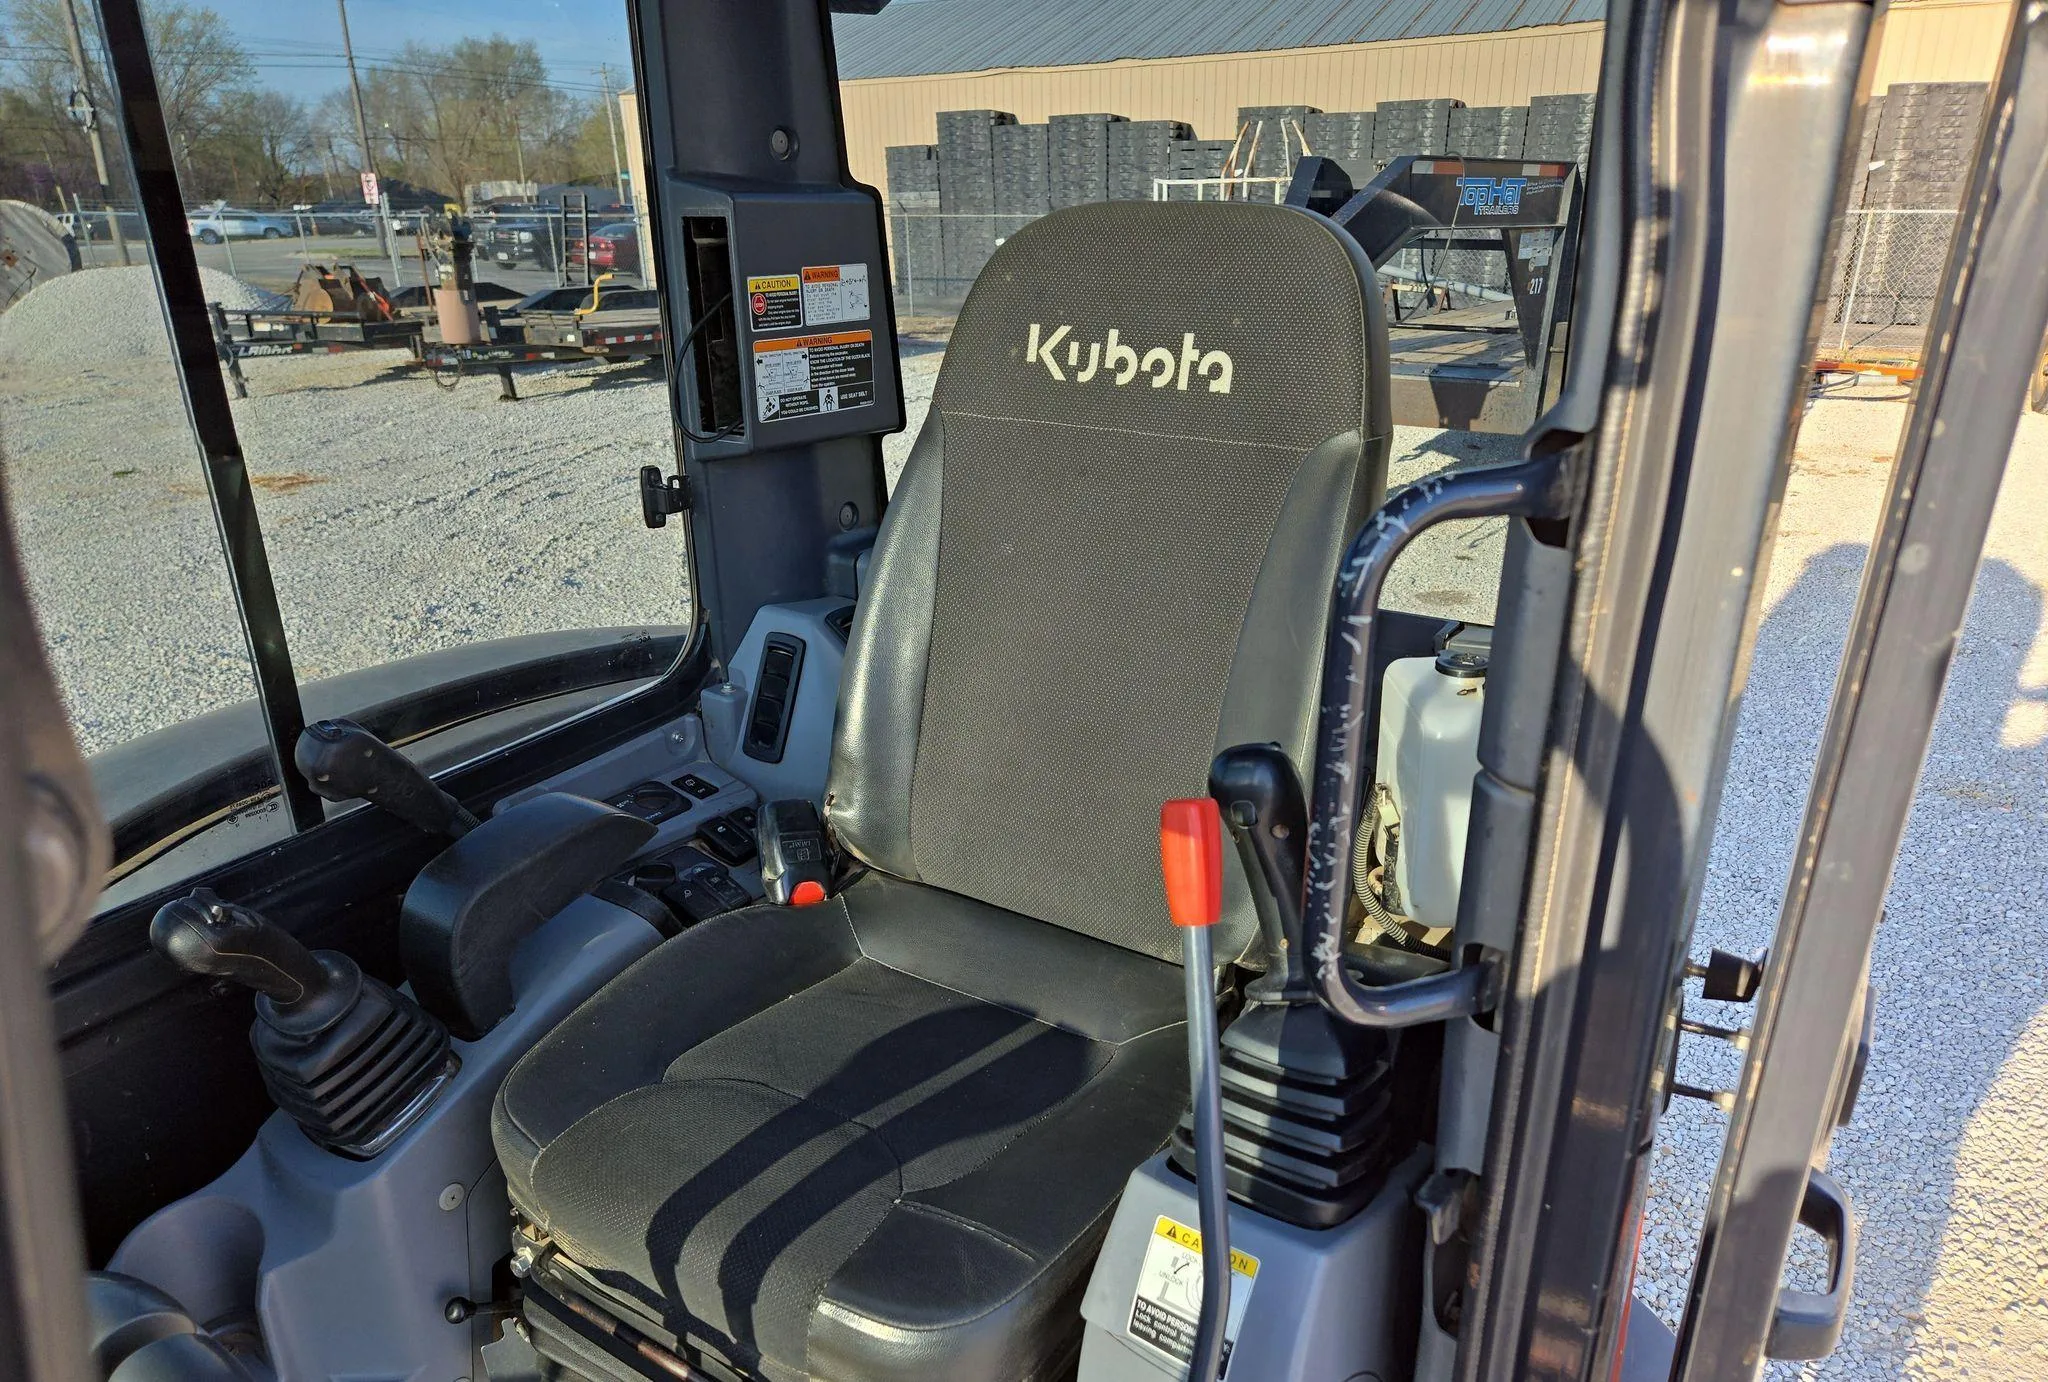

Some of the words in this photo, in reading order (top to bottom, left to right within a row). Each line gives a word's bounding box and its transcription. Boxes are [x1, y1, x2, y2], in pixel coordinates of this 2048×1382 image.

[812, 270, 839, 280] WARNING
[761, 280, 791, 290] CAUTION
[1529, 277, 1543, 295] 217
[803, 336, 833, 348] WARNING
[1026, 323, 1233, 394] Kubota
[1137, 1299, 1147, 1311] TO
[1146, 1304, 1167, 1322] AVOID
